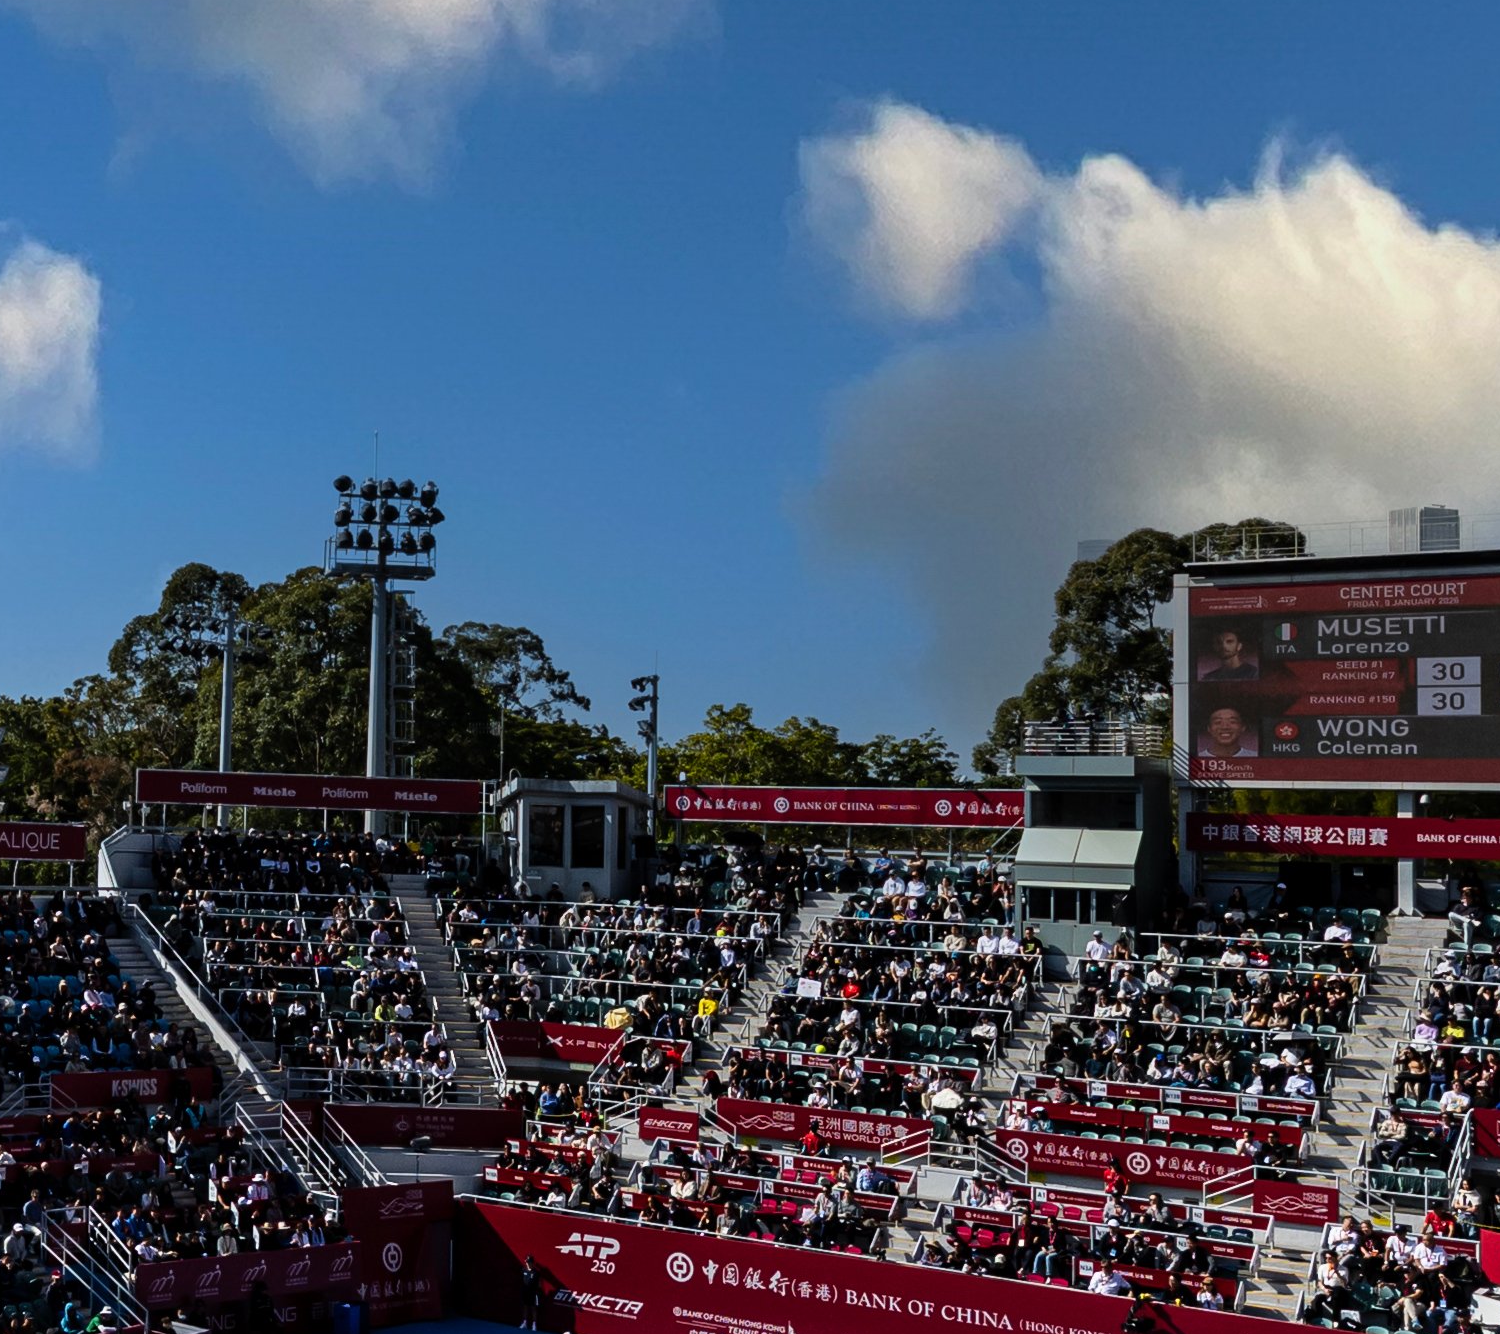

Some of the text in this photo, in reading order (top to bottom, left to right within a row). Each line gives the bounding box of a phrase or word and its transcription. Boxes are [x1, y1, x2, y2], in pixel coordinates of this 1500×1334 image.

[1340, 581, 1467, 601] CENTER COURT
[1318, 614, 1445, 637] MUSETTI
[1276, 644, 1297, 654] ITA
[1318, 640, 1410, 654] Lorenzo
[1335, 660, 1384, 669] SEED #1
[1322, 670, 1396, 681] RANKING #7
[1431, 662, 1465, 681] 30
[1309, 696, 1366, 705] RANKING
[1431, 692, 1465, 711] 30
[1317, 718, 1410, 738] WONG
[1273, 743, 1301, 753] HKG
[1317, 740, 1419, 755] Coleman
[180, 782, 227, 795] Poliform
[254, 785, 297, 798] Miele
[322, 787, 369, 800] Poliform
[394, 790, 438, 803] Miele
[793, 802, 875, 812] BANK OF CHINA
[1202, 823, 1389, 847] 中銀香港網球公開賽
[1416, 833, 1445, 843] BANK
[1447, 834, 1462, 843] OF
[1464, 835, 1497, 844] CHINA
[843, 1133, 881, 1144] WORLD
[556, 1233, 621, 1260] ATP
[590, 1259, 616, 1275] 250
[845, 1289, 902, 1313] BANK
[908, 1299, 935, 1317] OF
[941, 1304, 1015, 1331] CHINA
[682, 1309, 703, 1319] BANK
[714, 1314, 738, 1324] CHINA
[739, 1318, 762, 1330] HONG
[763, 1323, 786, 1334] KONG
